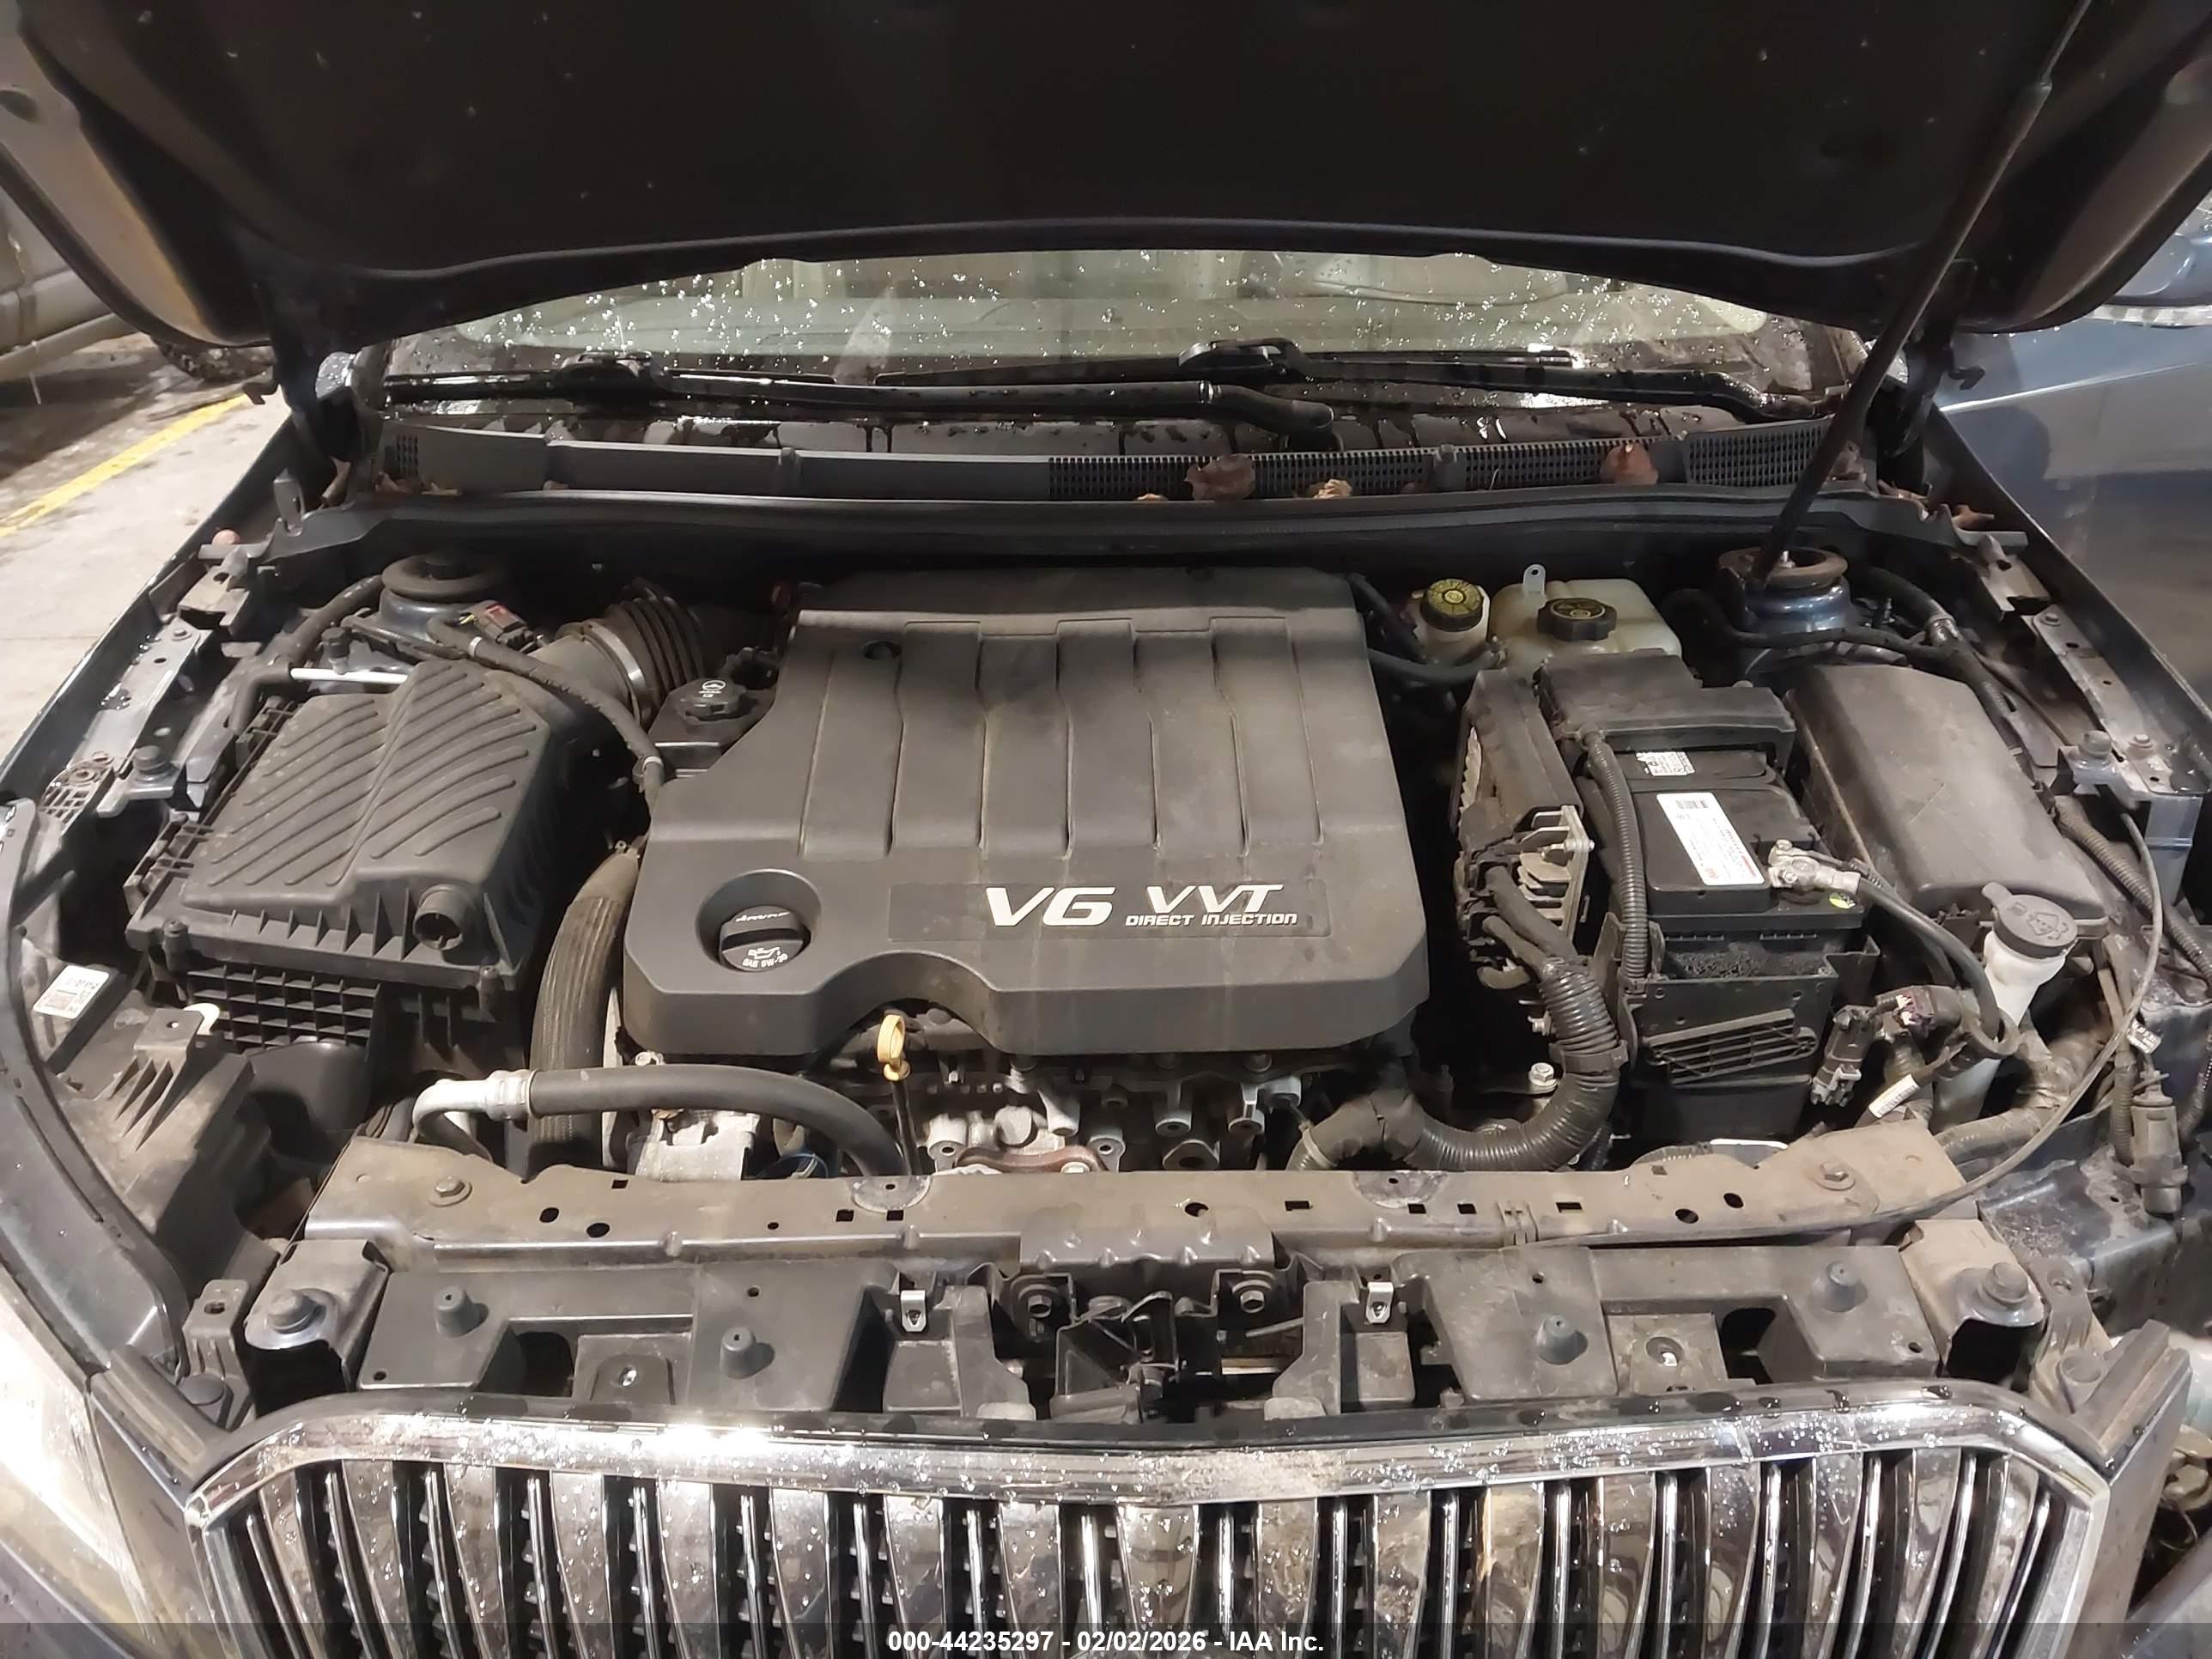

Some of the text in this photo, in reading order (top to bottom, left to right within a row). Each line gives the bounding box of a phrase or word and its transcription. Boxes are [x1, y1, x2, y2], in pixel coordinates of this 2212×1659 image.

[986, 884, 1285, 927] V6 VVT
[1125, 913, 1298, 927] DIRECT INJECTION
